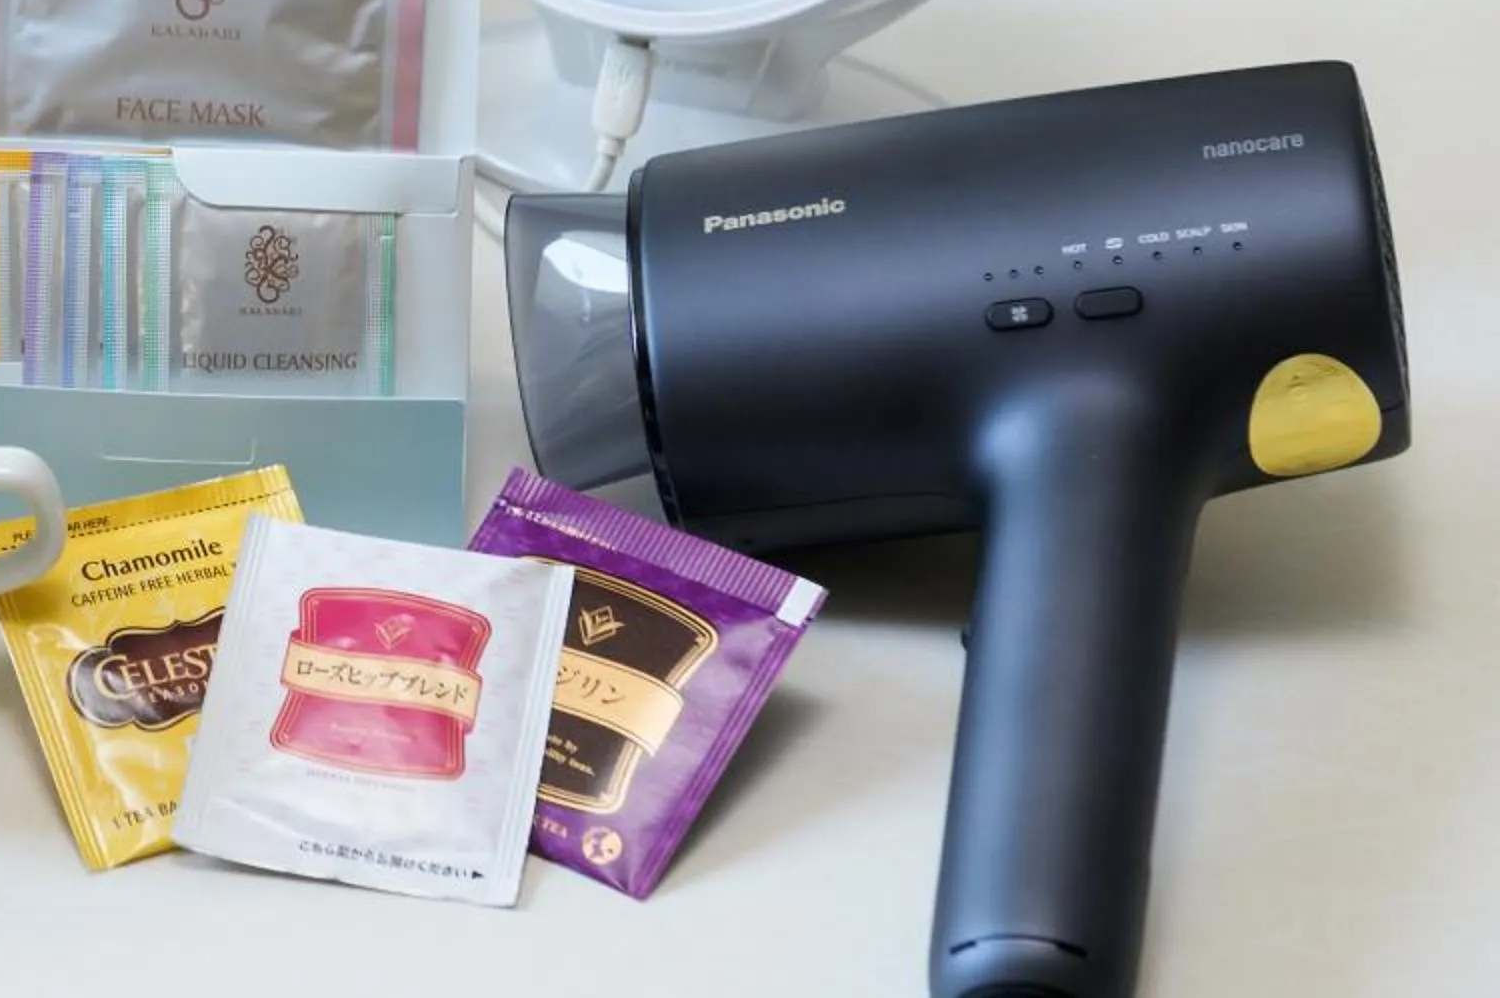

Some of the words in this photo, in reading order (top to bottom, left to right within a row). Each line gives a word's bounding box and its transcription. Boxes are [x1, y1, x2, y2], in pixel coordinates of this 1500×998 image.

[115, 97, 182, 124] FACE
[190, 101, 265, 128] MASK
[1202, 133, 1305, 160] nanocare
[703, 197, 846, 234] Panasonic
[1137, 231, 1171, 244] COLD
[182, 353, 247, 373] LIQUID
[253, 353, 357, 372] CLEANSING
[81, 538, 224, 582] Chamomile
[71, 584, 139, 608] CAFFEINE
[139, 575, 173, 594] FREE
[175, 565, 230, 585] HERBAL
[93, 642, 219, 700] CELEST
[297, 659, 470, 704] ローズヒップブレンド
[555, 665, 628, 704] ジリン
